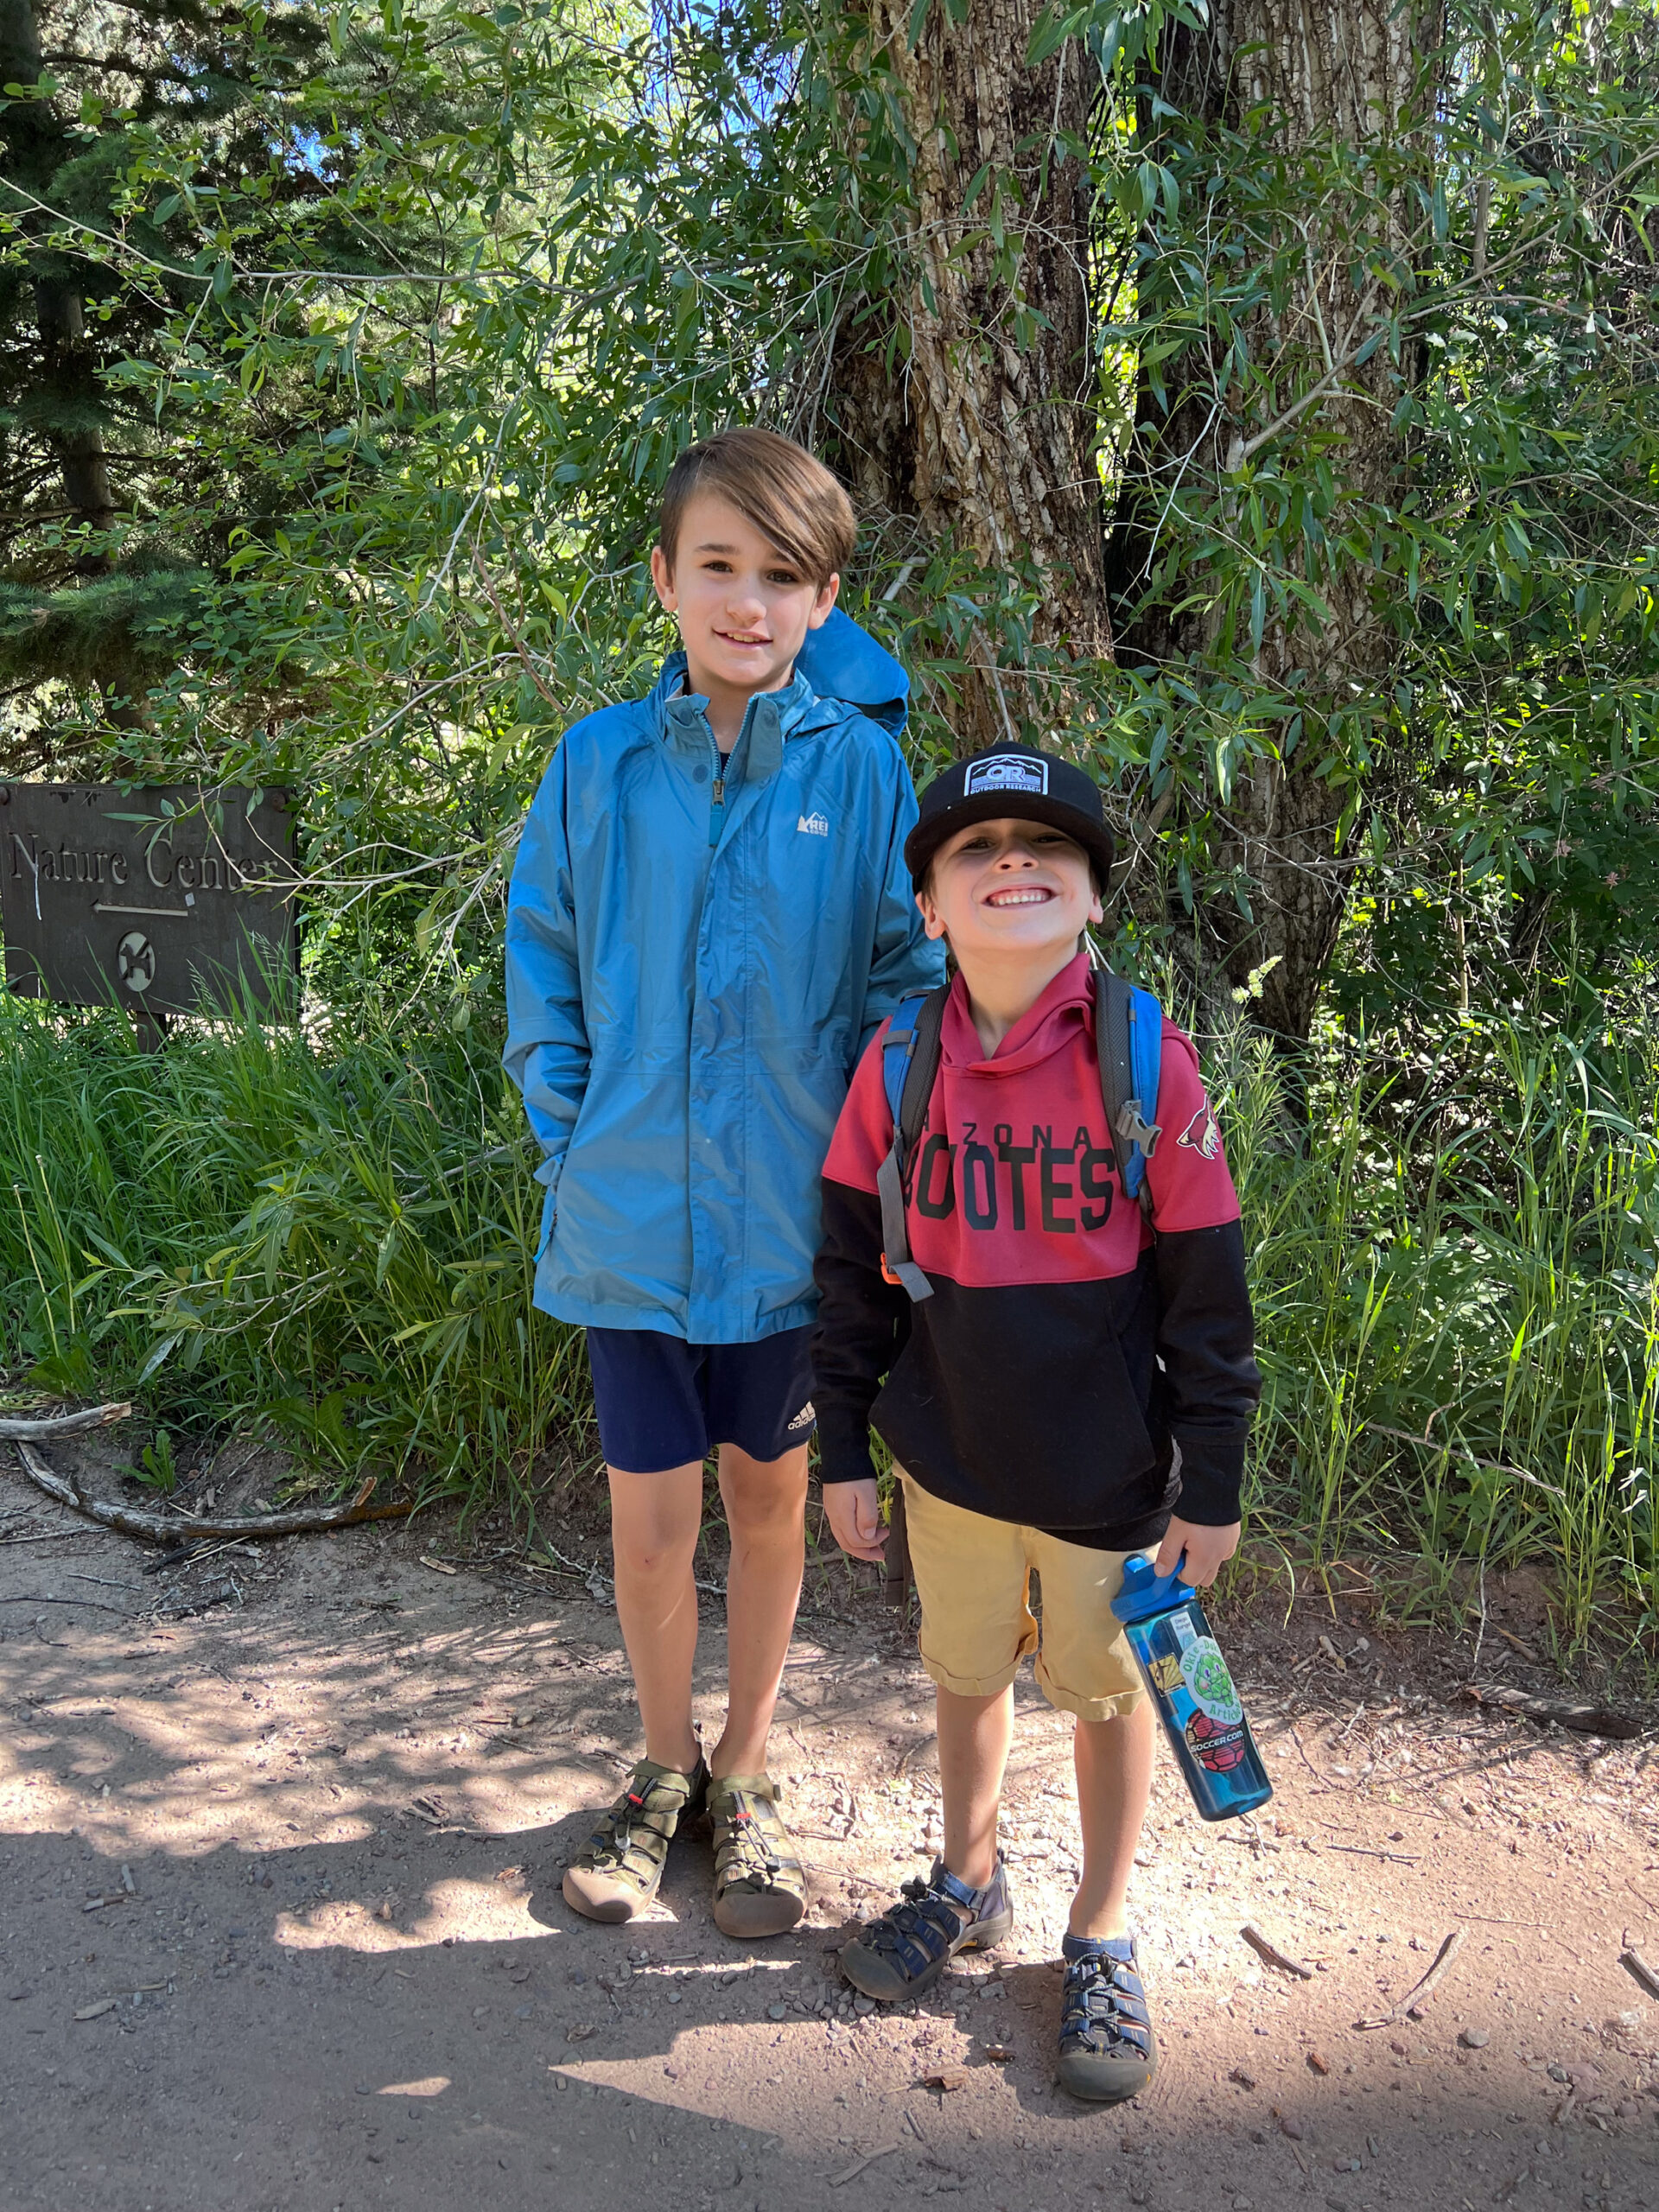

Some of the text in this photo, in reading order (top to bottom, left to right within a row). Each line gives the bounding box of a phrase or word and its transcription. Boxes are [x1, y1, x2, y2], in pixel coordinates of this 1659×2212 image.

[986, 765, 1026, 783] OR
[969, 784, 1041, 795] OUTDOOR RESEARCH
[810, 820, 828, 831] REI
[9, 832, 278, 893] Nature Center
[924, 1109, 1092, 1149] ZONA
[905, 1133, 1116, 1234] OOTES
